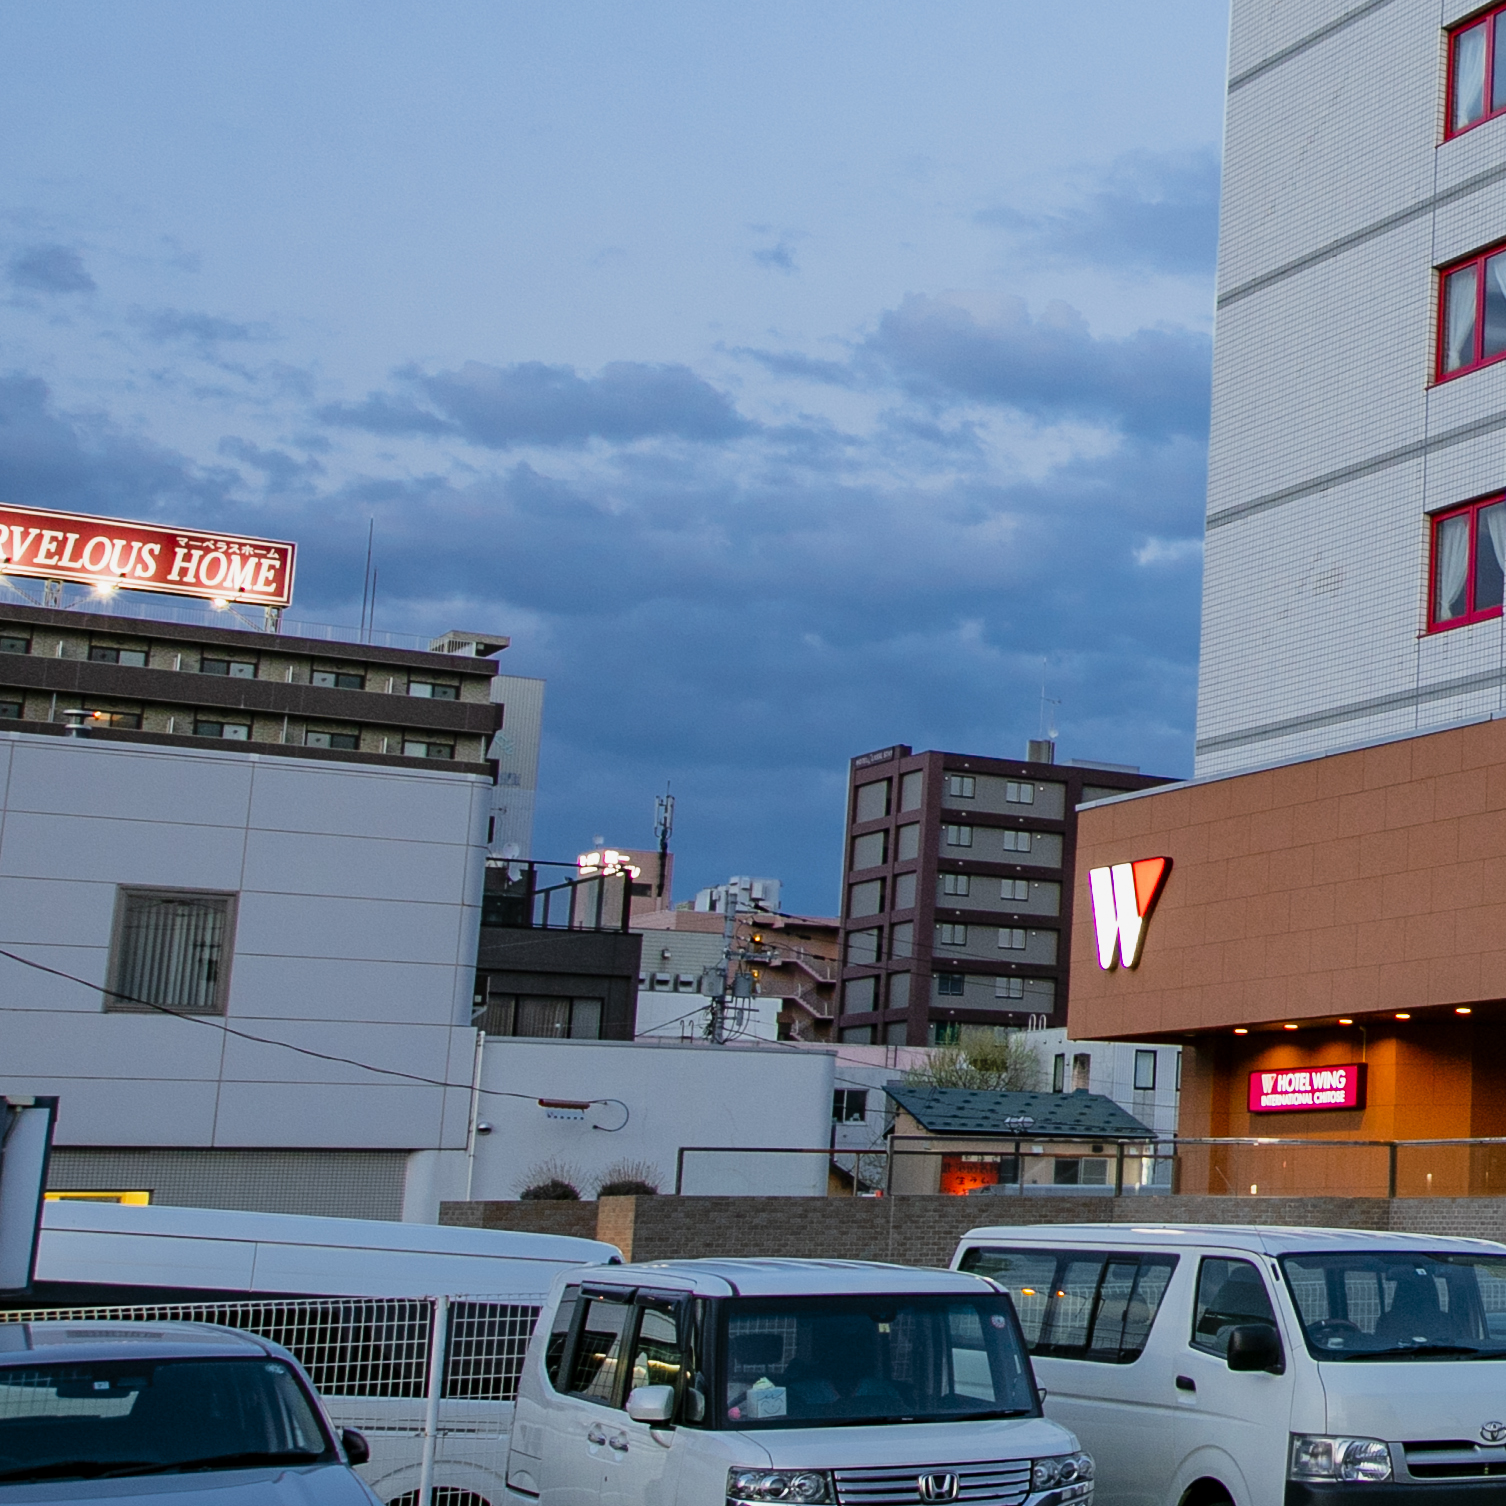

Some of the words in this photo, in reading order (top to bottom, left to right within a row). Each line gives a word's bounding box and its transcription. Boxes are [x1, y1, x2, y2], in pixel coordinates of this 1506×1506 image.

[176, 536, 280, 559] マーベラスホーム
[166, 547, 281, 593] HOME
[1277, 1072, 1311, 1092] HOTEL
[1311, 1070, 1346, 1090] WING
[1261, 1093, 1313, 1107] INTERNATIONAL
[1313, 1090, 1346, 1104] CHITOSE
